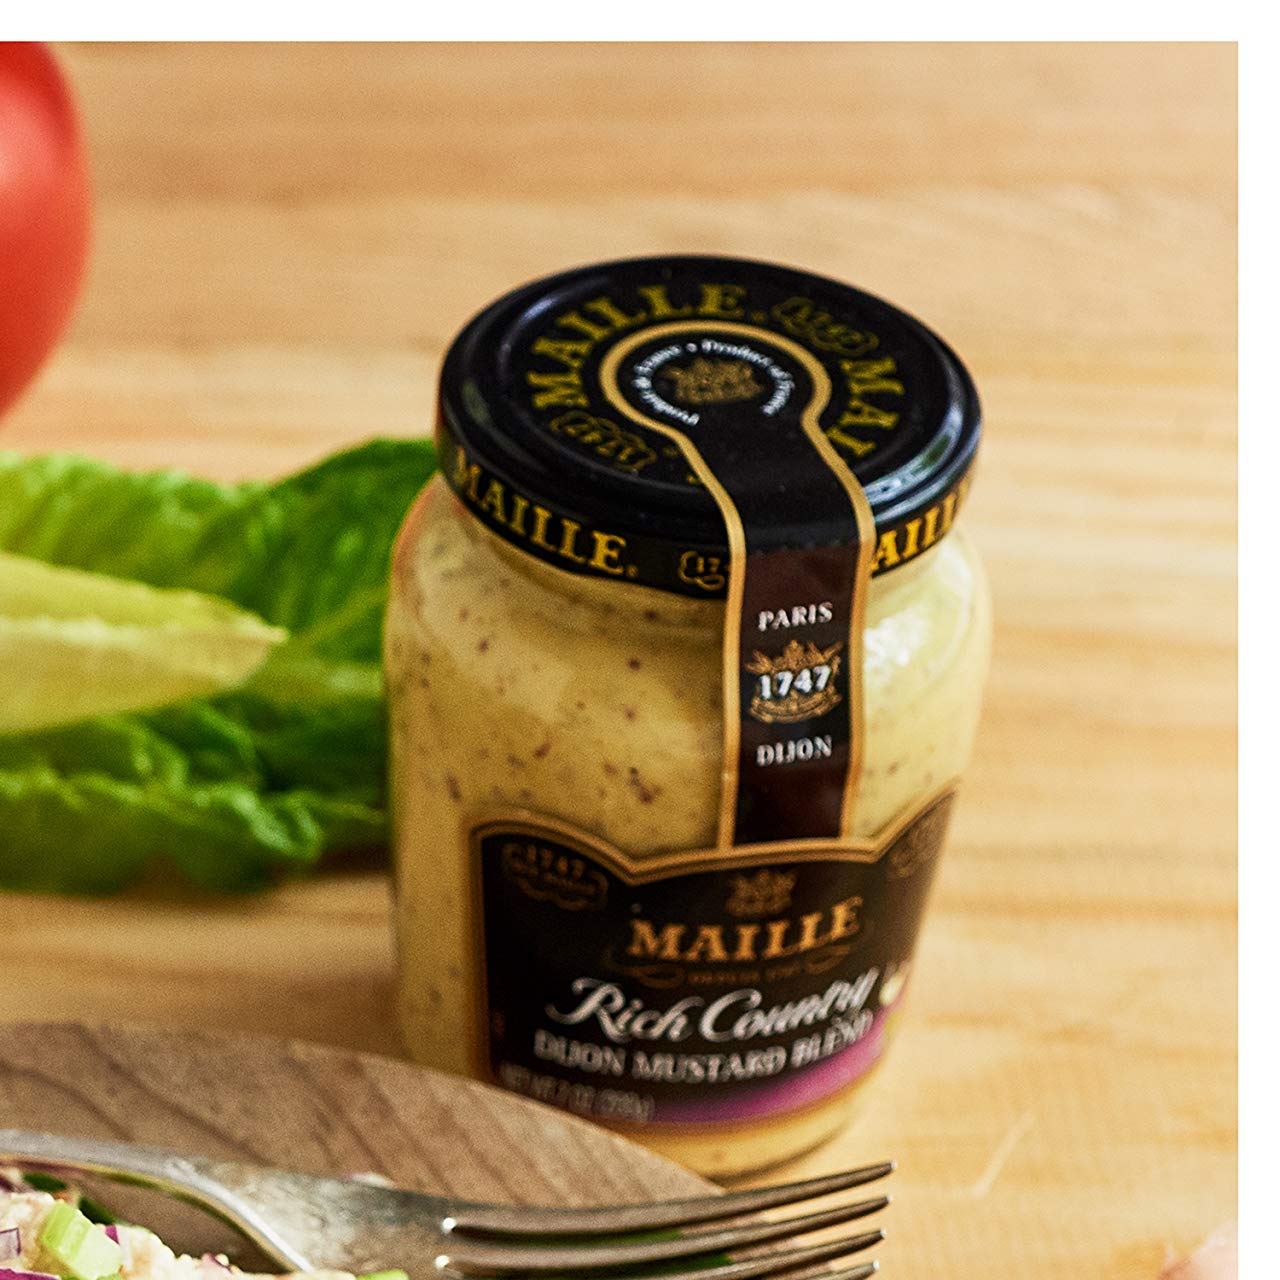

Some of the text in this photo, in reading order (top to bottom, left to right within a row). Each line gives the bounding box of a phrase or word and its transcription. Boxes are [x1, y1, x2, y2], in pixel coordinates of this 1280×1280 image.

[526, 282, 747, 409] MAILLE
[822, 354, 905, 457] MAI
[453, 447, 627, 576] MAILLE
[757, 601, 834, 632] PARIS
[758, 663, 832, 700] 1747
[755, 734, 833, 768] DIJON
[627, 897, 864, 962] MAILLE
[544, 976, 706, 1043] Rich
[698, 966, 880, 1043] Country
[532, 1007, 874, 1084] DIJON MUSTARD BLEND
